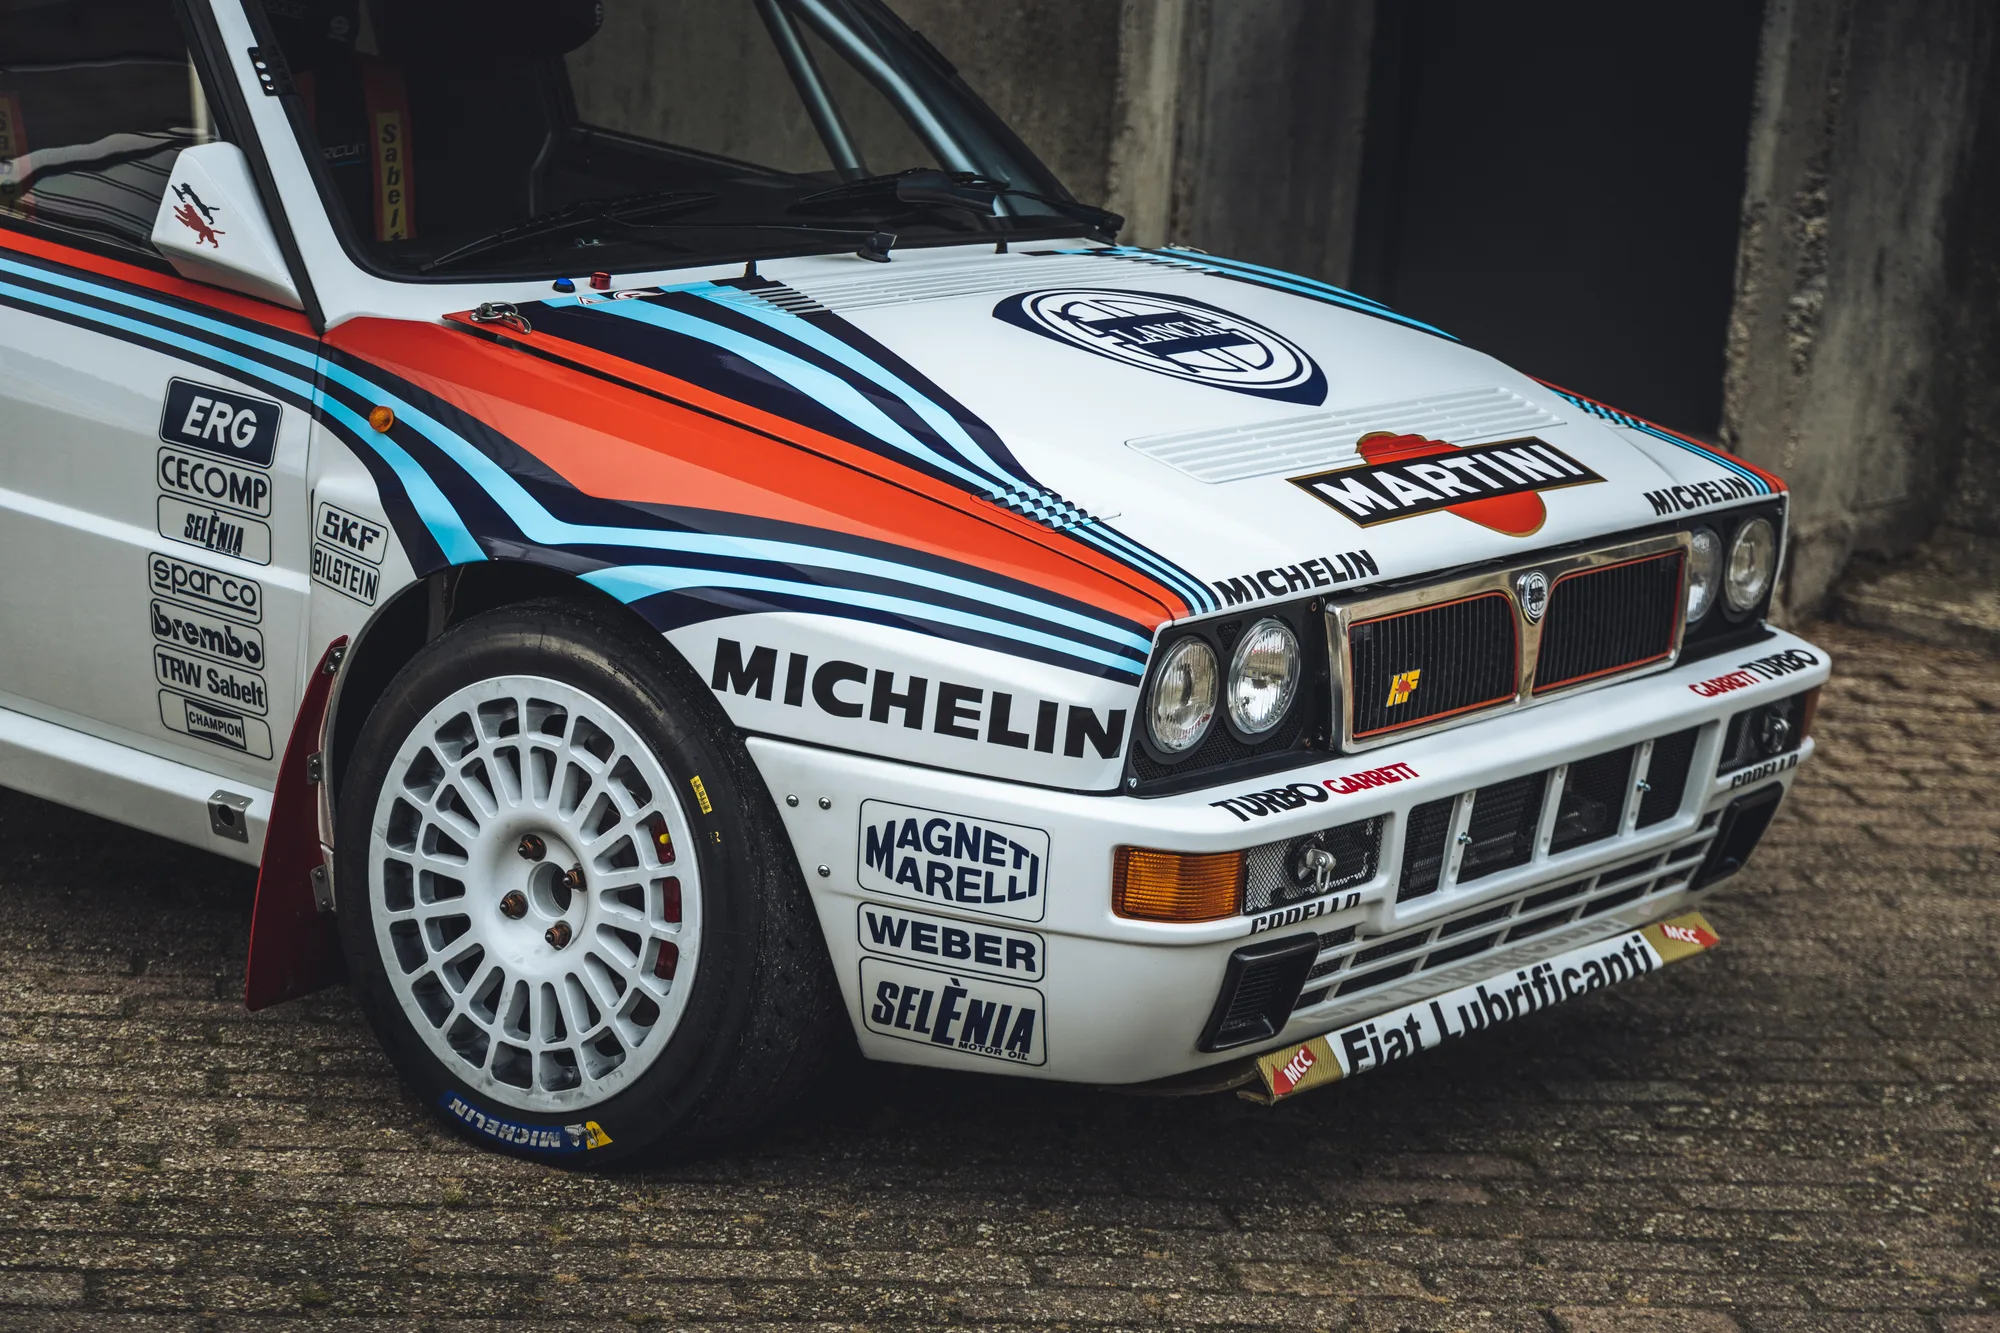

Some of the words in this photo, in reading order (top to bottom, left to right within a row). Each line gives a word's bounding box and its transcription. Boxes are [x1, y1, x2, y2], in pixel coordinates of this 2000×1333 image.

[1109, 321, 1230, 344] LANCIA
[181, 396, 257, 449] ERG
[161, 456, 267, 510] CECOMP
[1312, 443, 1585, 516] MARTINI
[1642, 476, 1753, 516] MICHELIN
[322, 510, 380, 552] SKF
[153, 559, 257, 607] sparco
[313, 549, 377, 601] BILSTEIN
[1211, 549, 1379, 606] MICHELIN
[153, 604, 261, 664] brembo
[157, 652, 201, 688] TRW
[206, 668, 265, 708] Sabelt
[711, 638, 1127, 760] MICHELIN
[1688, 670, 1760, 697] GARRETT
[1738, 649, 1819, 680] TURBO
[188, 711, 243, 739] CHAMPION
[1208, 783, 1329, 822] TURBO
[1322, 762, 1420, 795] GARRETT
[866, 818, 1039, 886] MAGNETI
[866, 836, 1039, 903] MARELLI
[865, 911, 1036, 973] WEBER
[1664, 924, 1700, 944] MCC
[871, 977, 1036, 1055] SELÈNIA
[1340, 1012, 1426, 1074] Fiat
[1429, 935, 1650, 1038] Lubrificanti
[958, 1040, 1003, 1057] MOTOR
[1007, 1049, 1028, 1061] OIL
[1283, 1049, 1313, 1085] MCC
[448, 1098, 561, 1148] MICHELIN
